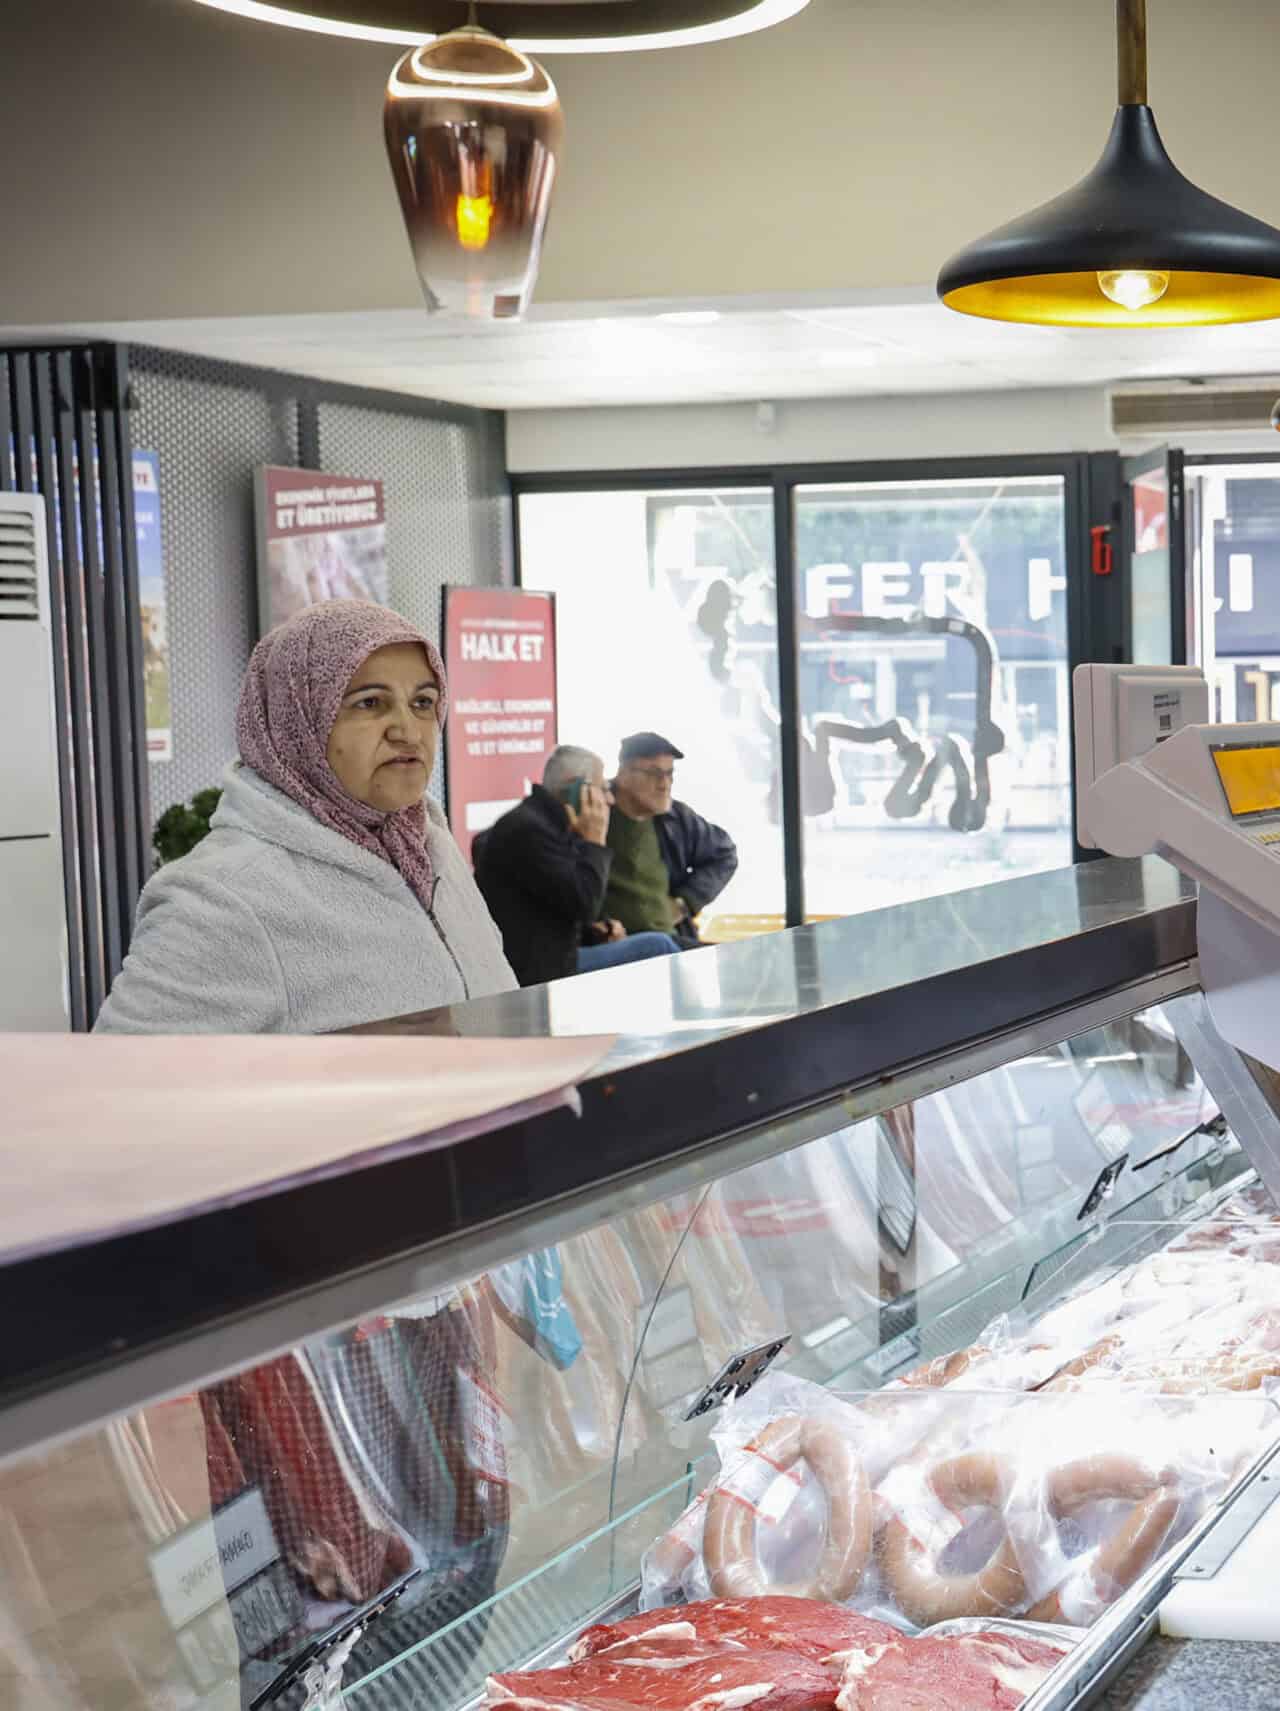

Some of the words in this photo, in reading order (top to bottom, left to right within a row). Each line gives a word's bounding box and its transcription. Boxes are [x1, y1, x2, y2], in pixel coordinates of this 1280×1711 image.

[276, 509, 293, 529] ET
[461, 632, 518, 662] HALK
[519, 634, 545, 662] ET
